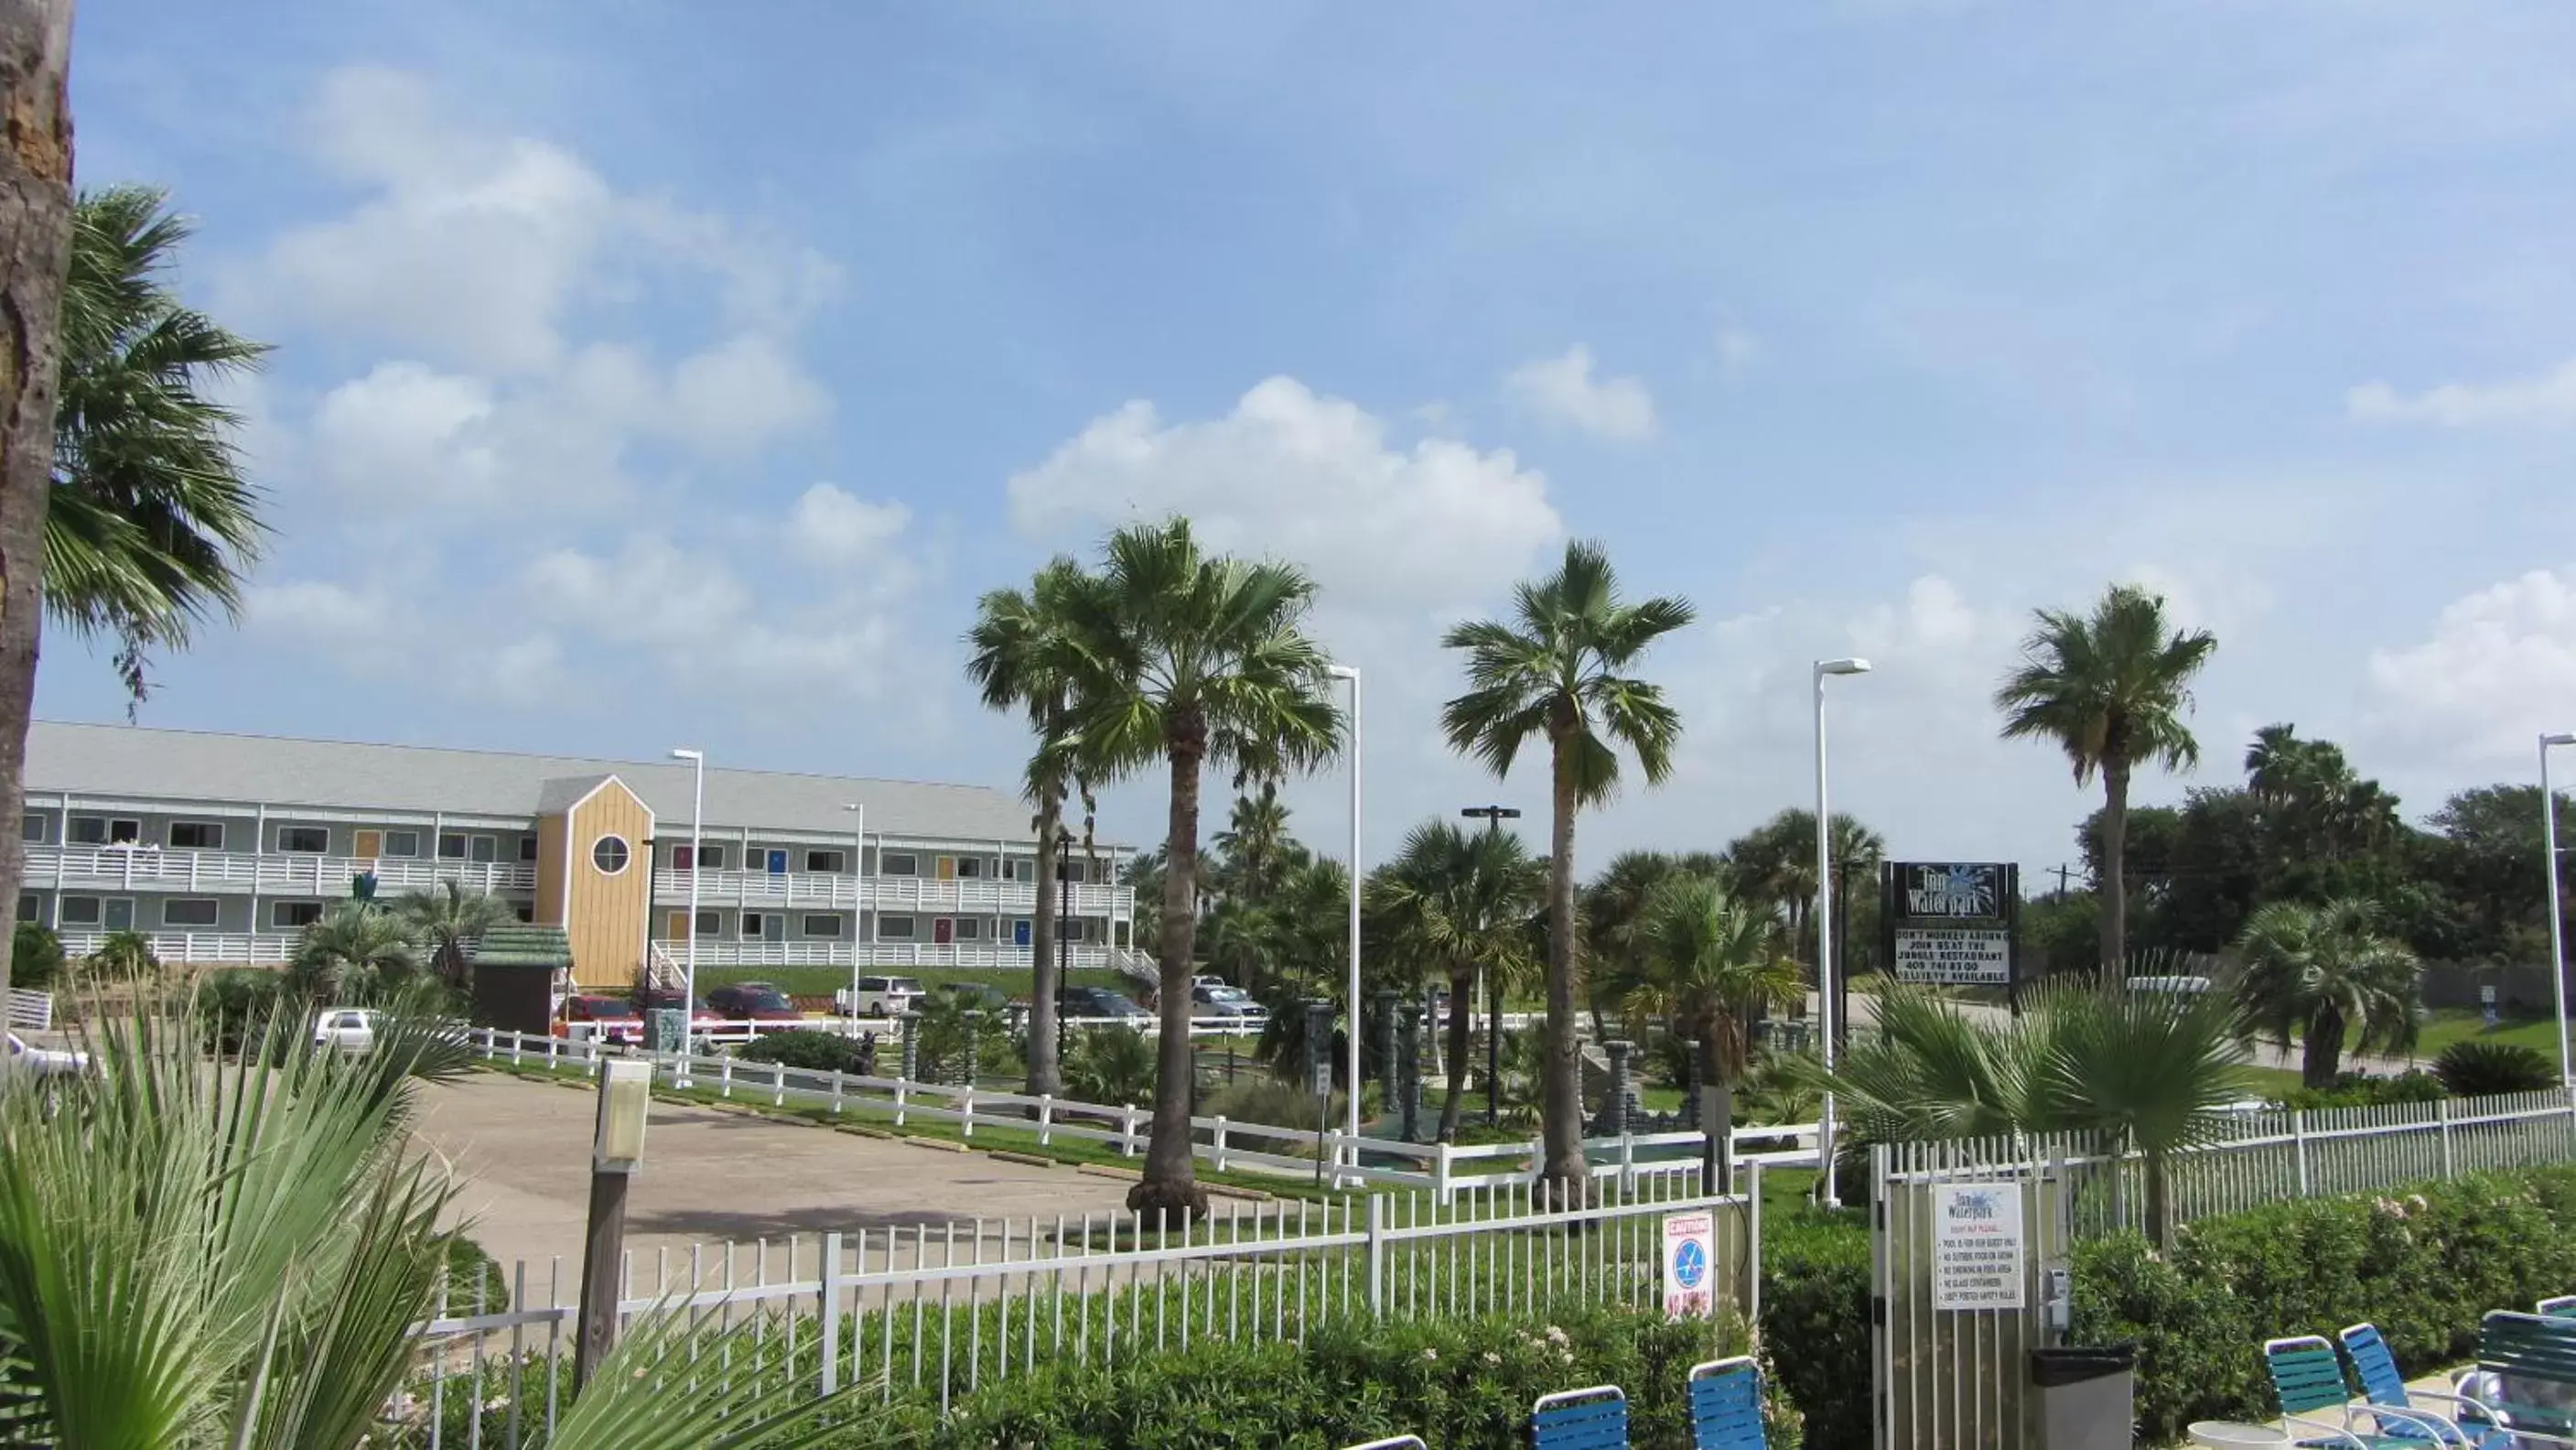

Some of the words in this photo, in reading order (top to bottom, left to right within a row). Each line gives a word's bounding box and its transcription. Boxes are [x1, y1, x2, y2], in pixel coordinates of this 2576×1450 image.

[1918, 865, 1945, 892] Inn
[1926, 931, 1966, 941] MONKEY
[1910, 941, 1932, 950] JOIN
[1968, 941, 1986, 950] THE
[1898, 951, 1935, 960] JUNGLE
[1940, 951, 2003, 961] RESTAURANT
[1952, 971, 2006, 981] AVAILABLE
